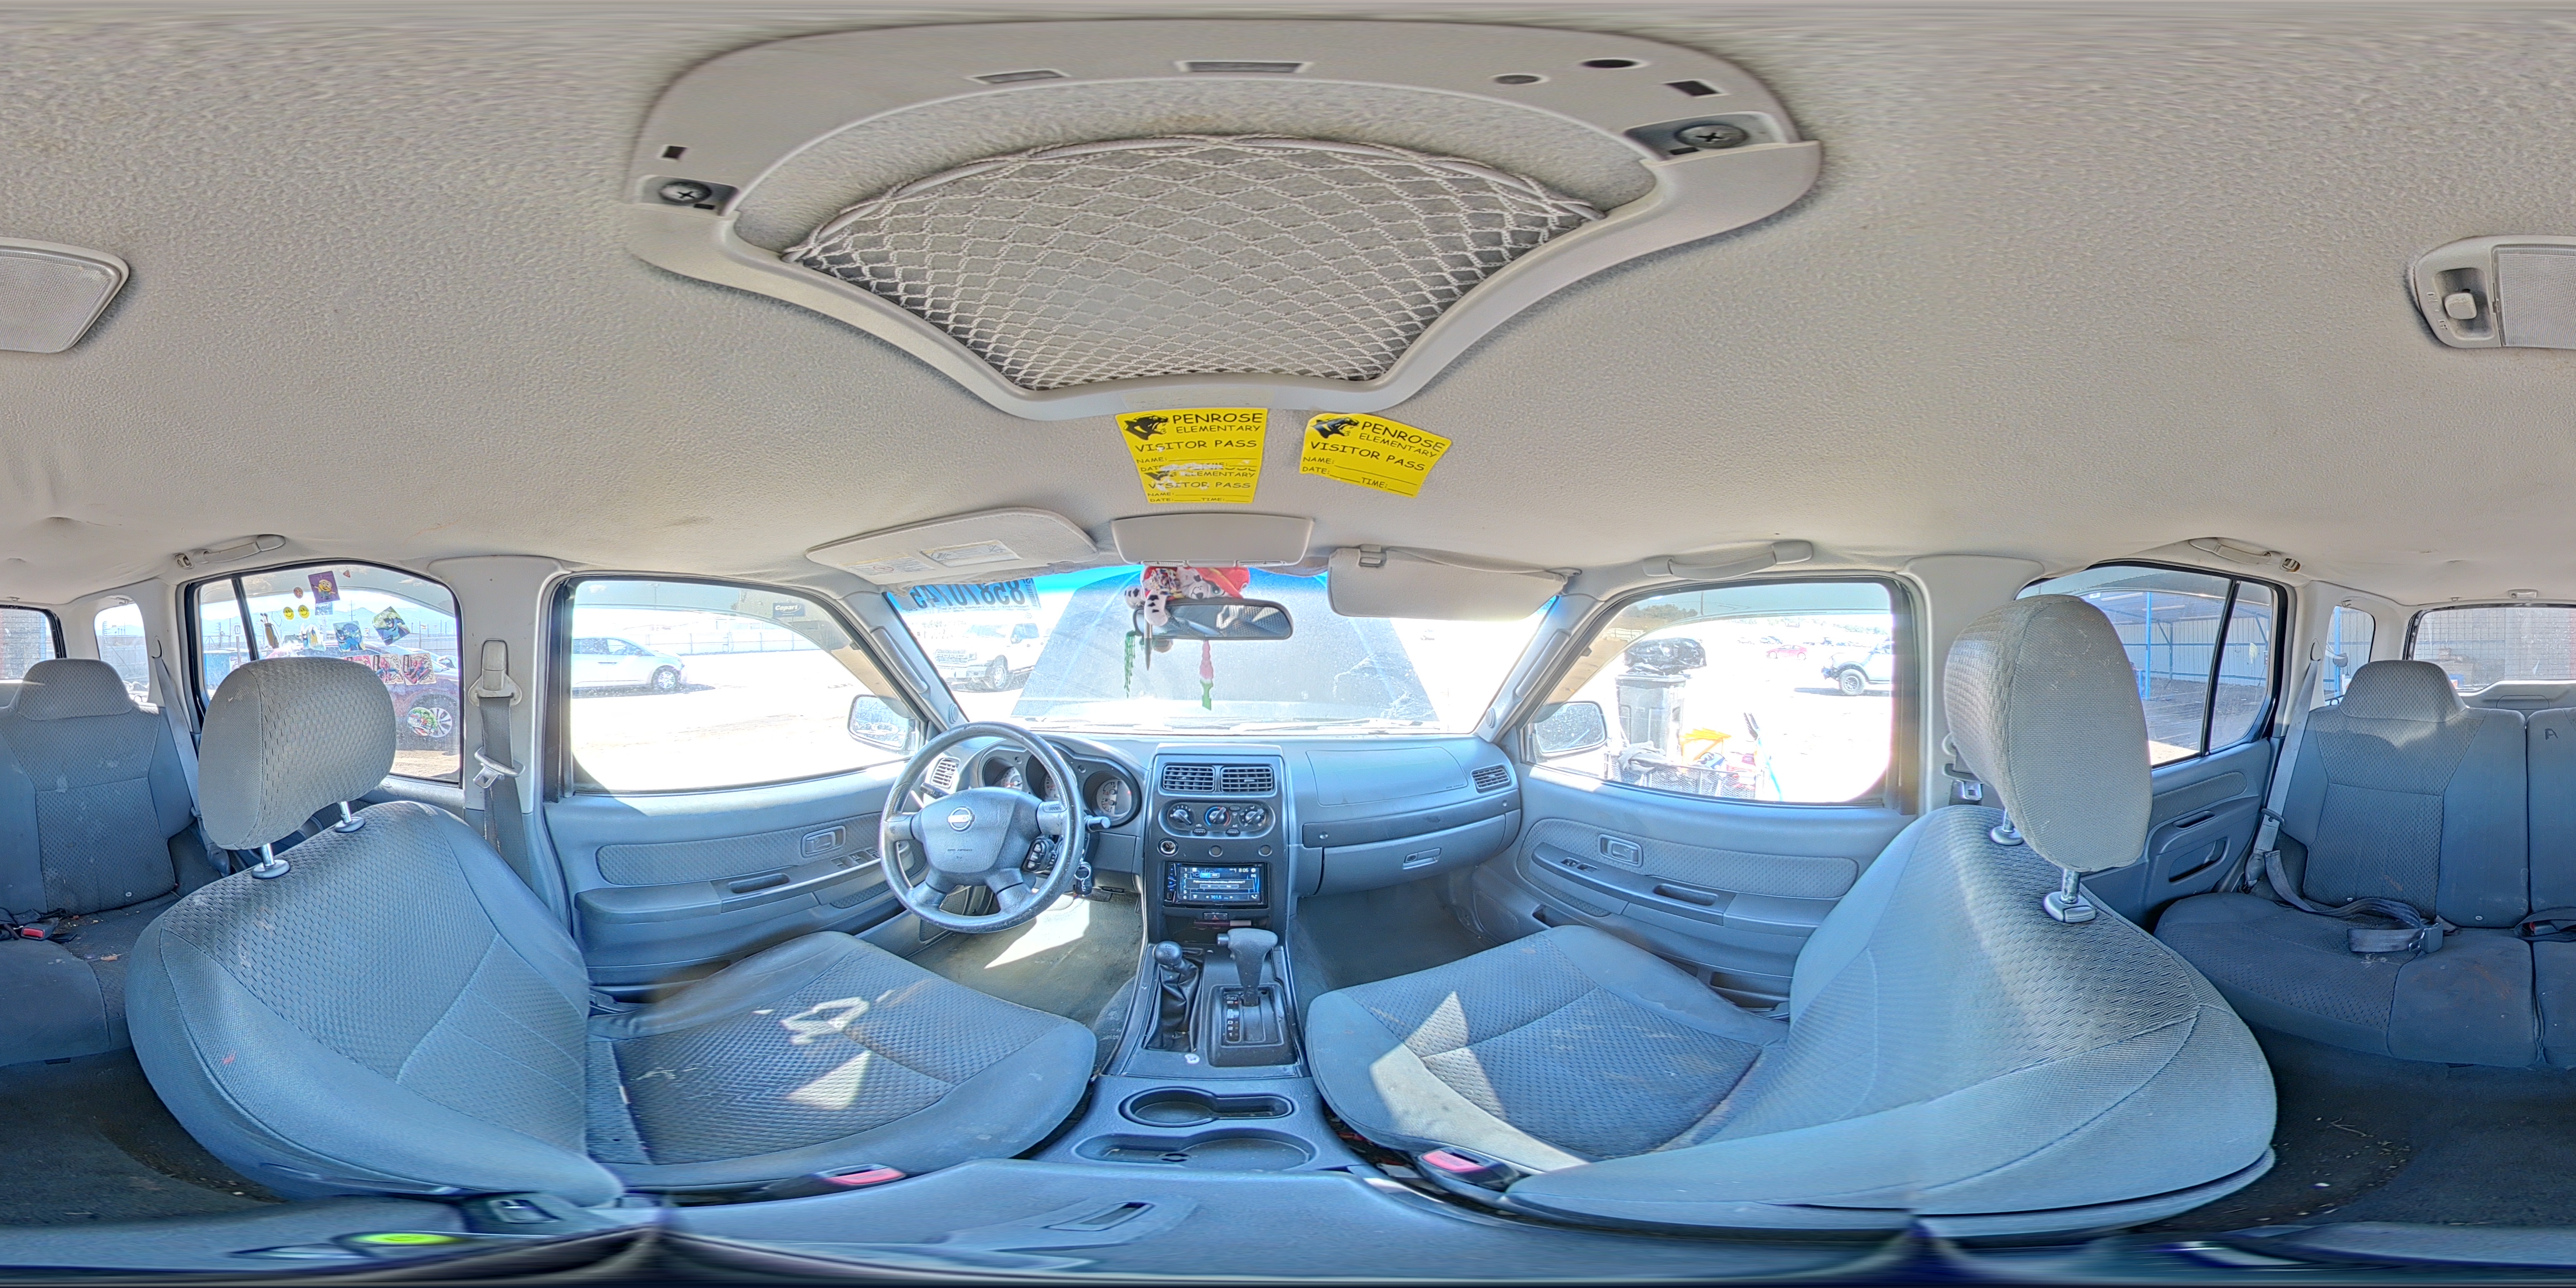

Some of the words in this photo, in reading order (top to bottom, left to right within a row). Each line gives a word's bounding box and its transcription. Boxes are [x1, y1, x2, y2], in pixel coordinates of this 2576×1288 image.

[1172, 413, 1263, 424] PENROSE
[1176, 425, 1261, 434] ELEMENTARY
[1361, 421, 1446, 453] PENROSE
[1134, 440, 1208, 453] VISITOR
[1359, 433, 1437, 458] ELEMENTARY
[1310, 441, 1380, 460] VISITOR
[1386, 454, 1426, 471] PASS
[1302, 466, 1330, 475] DATE:
[1361, 476, 1388, 489] TIME:
[2545, 728, 2558, 740] A
